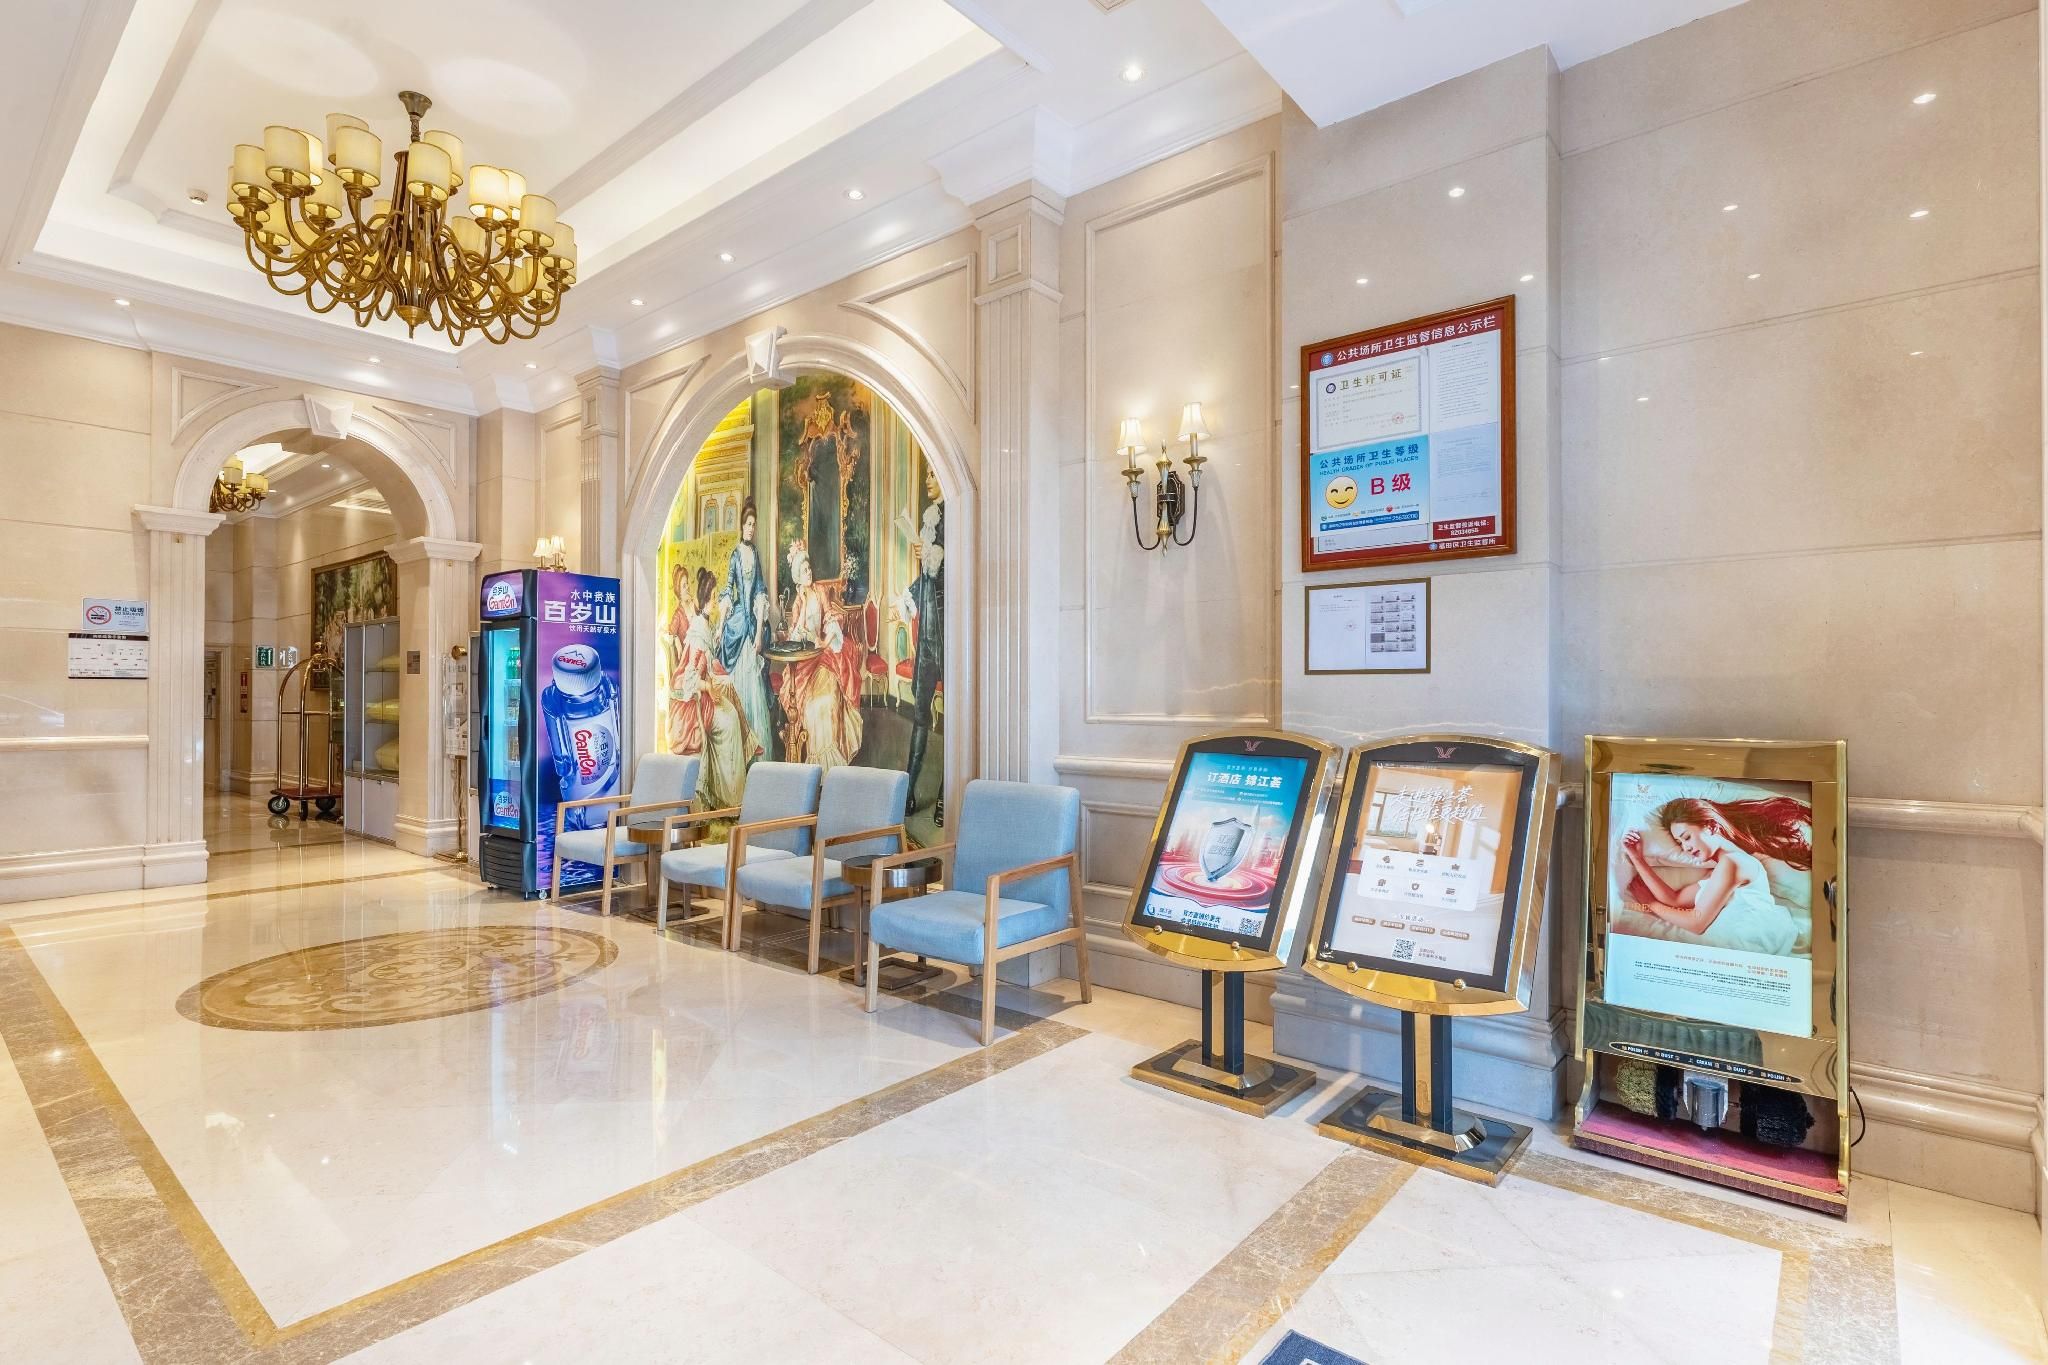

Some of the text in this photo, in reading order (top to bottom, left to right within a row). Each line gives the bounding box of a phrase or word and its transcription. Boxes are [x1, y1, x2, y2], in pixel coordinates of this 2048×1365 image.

[1337, 314, 1496, 361] 公共场所卫生监督信息公示栏
[1339, 368, 1402, 391] 卫生许可证
[1320, 443, 1419, 469] 公共场所卫生等级
[1371, 472, 1411, 496] B 级
[570, 589, 616, 604] 水中贵族
[543, 600, 617, 625] 百岁山
[568, 624, 617, 634] 饮用天然矿泉水
[1207, 771, 1242, 785] 订酒店
